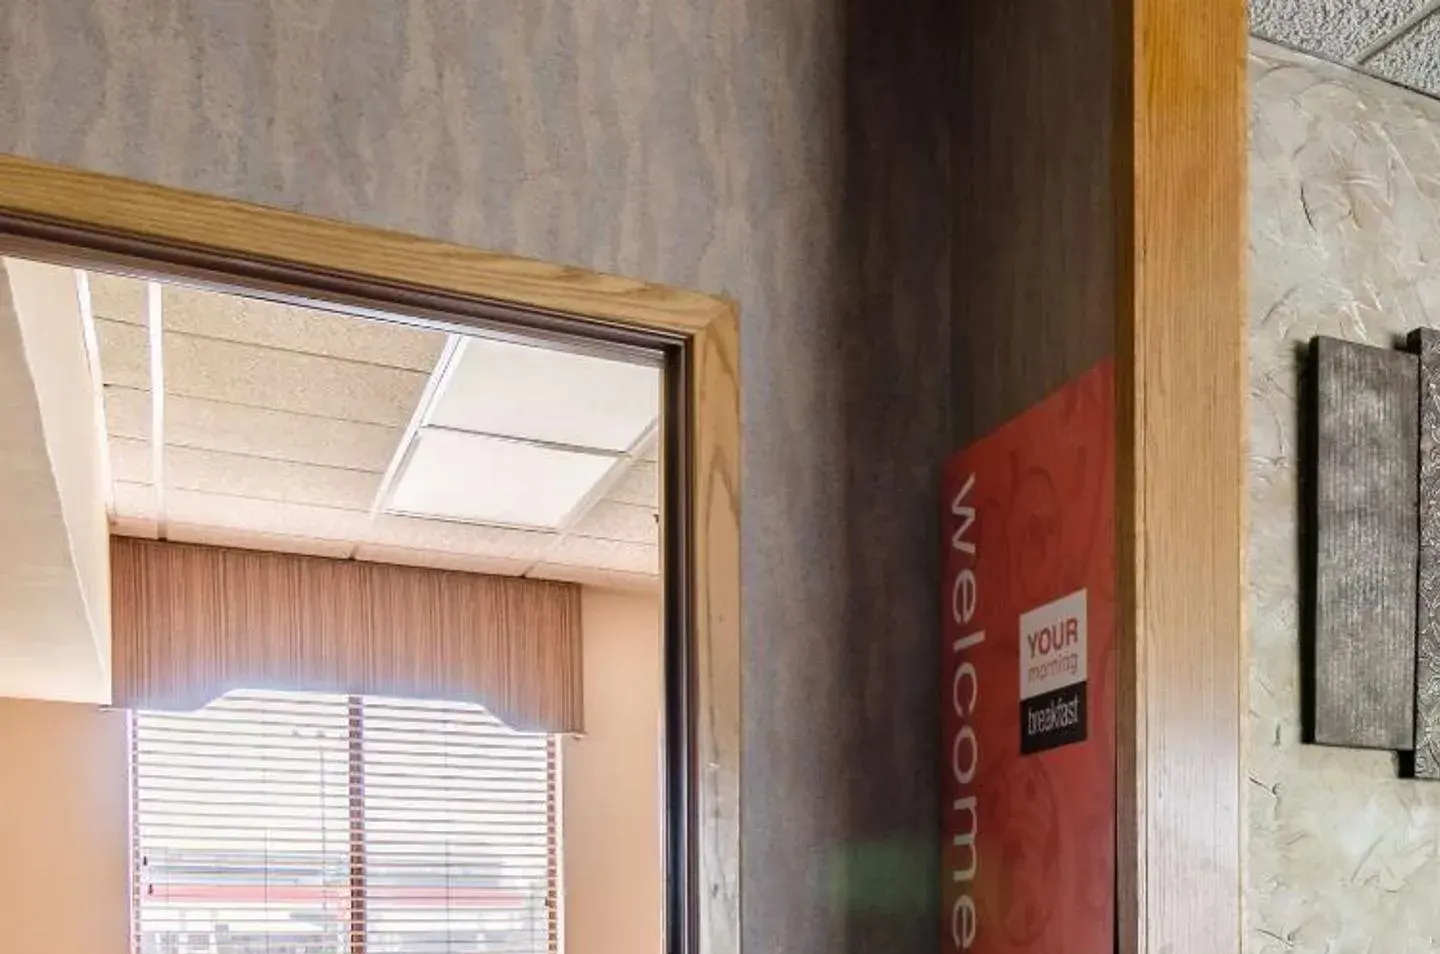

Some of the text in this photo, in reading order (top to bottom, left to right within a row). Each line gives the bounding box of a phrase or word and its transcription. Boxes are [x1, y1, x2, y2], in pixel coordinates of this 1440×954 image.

[1028, 618, 1078, 659] YOUR
[1028, 652, 1078, 684] morning
[952, 473, 984, 951] welcome
[1028, 694, 1078, 735] breakfast
